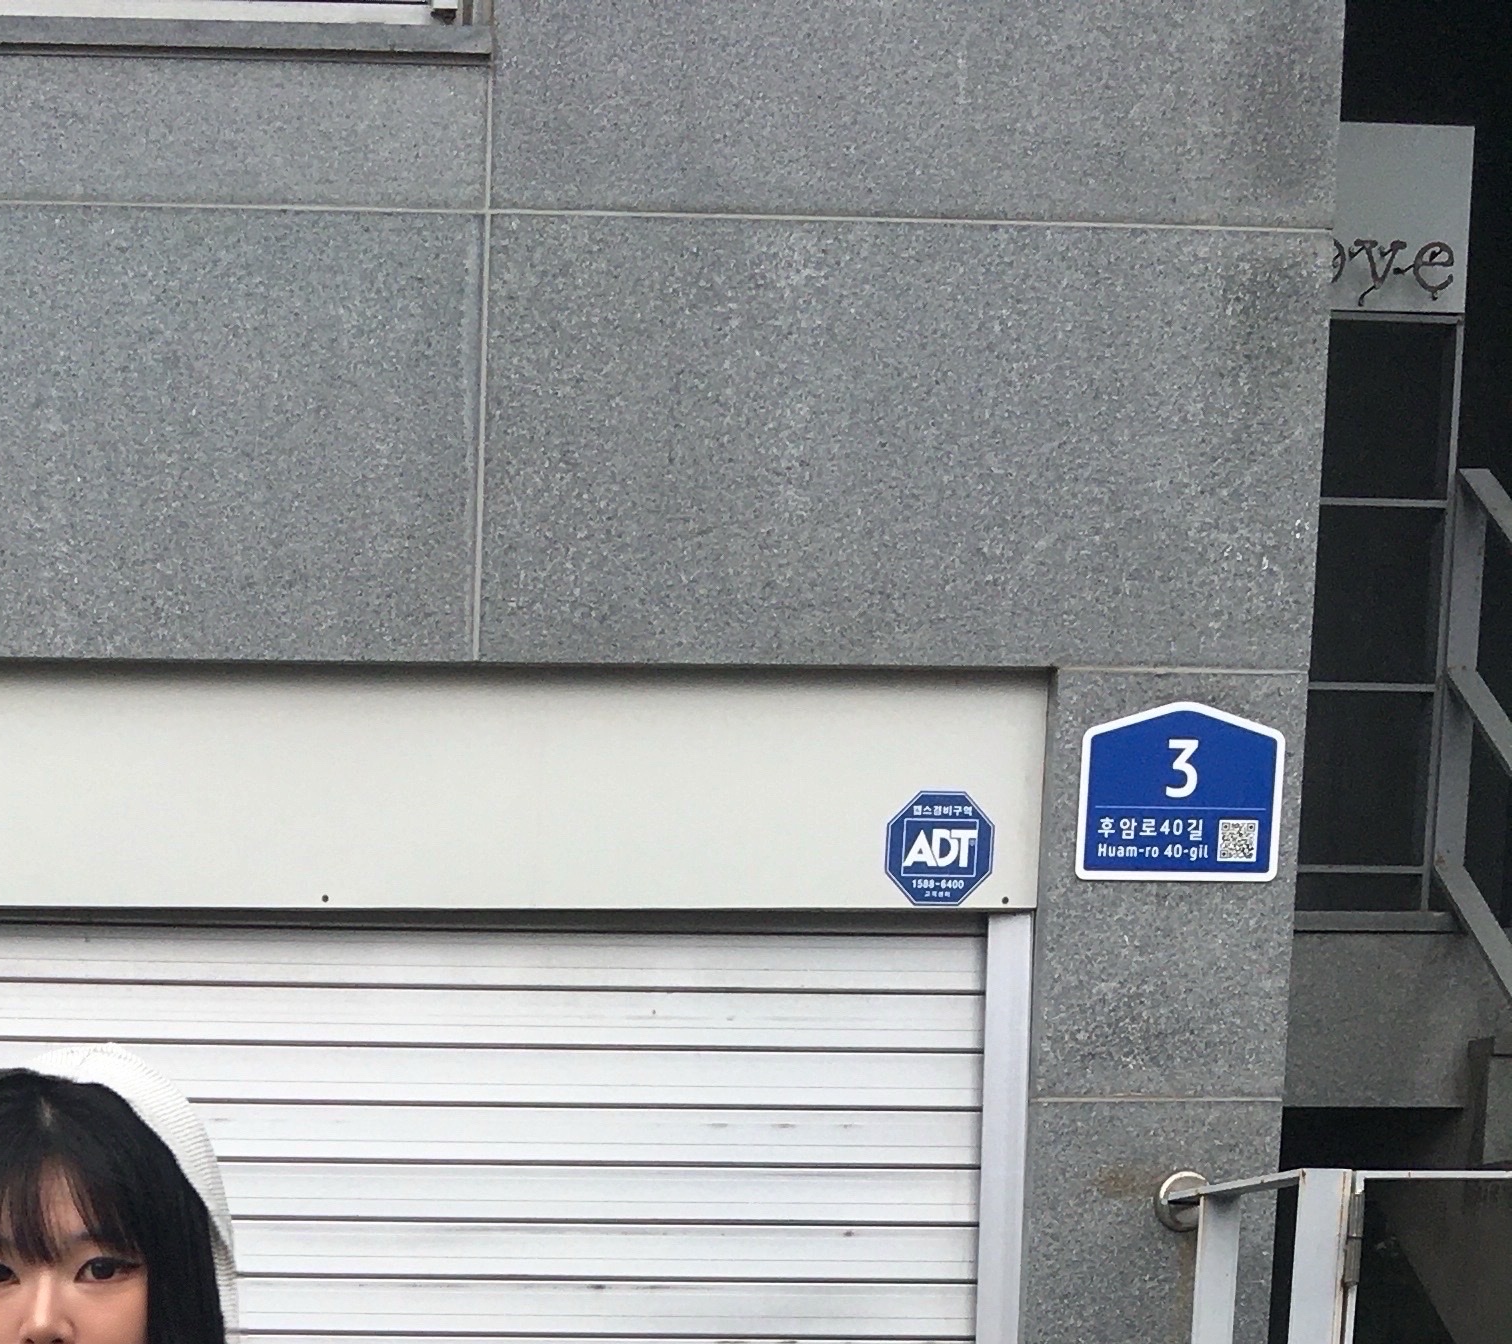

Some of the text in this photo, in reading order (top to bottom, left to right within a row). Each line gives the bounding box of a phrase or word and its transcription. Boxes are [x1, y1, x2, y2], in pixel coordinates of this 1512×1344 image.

[1165, 738, 1199, 798] 3
[1097, 816, 1204, 841] 후암로40길
[903, 828, 979, 868] ADT
[1097, 842, 1209, 861] Huam-ro 40-gil
